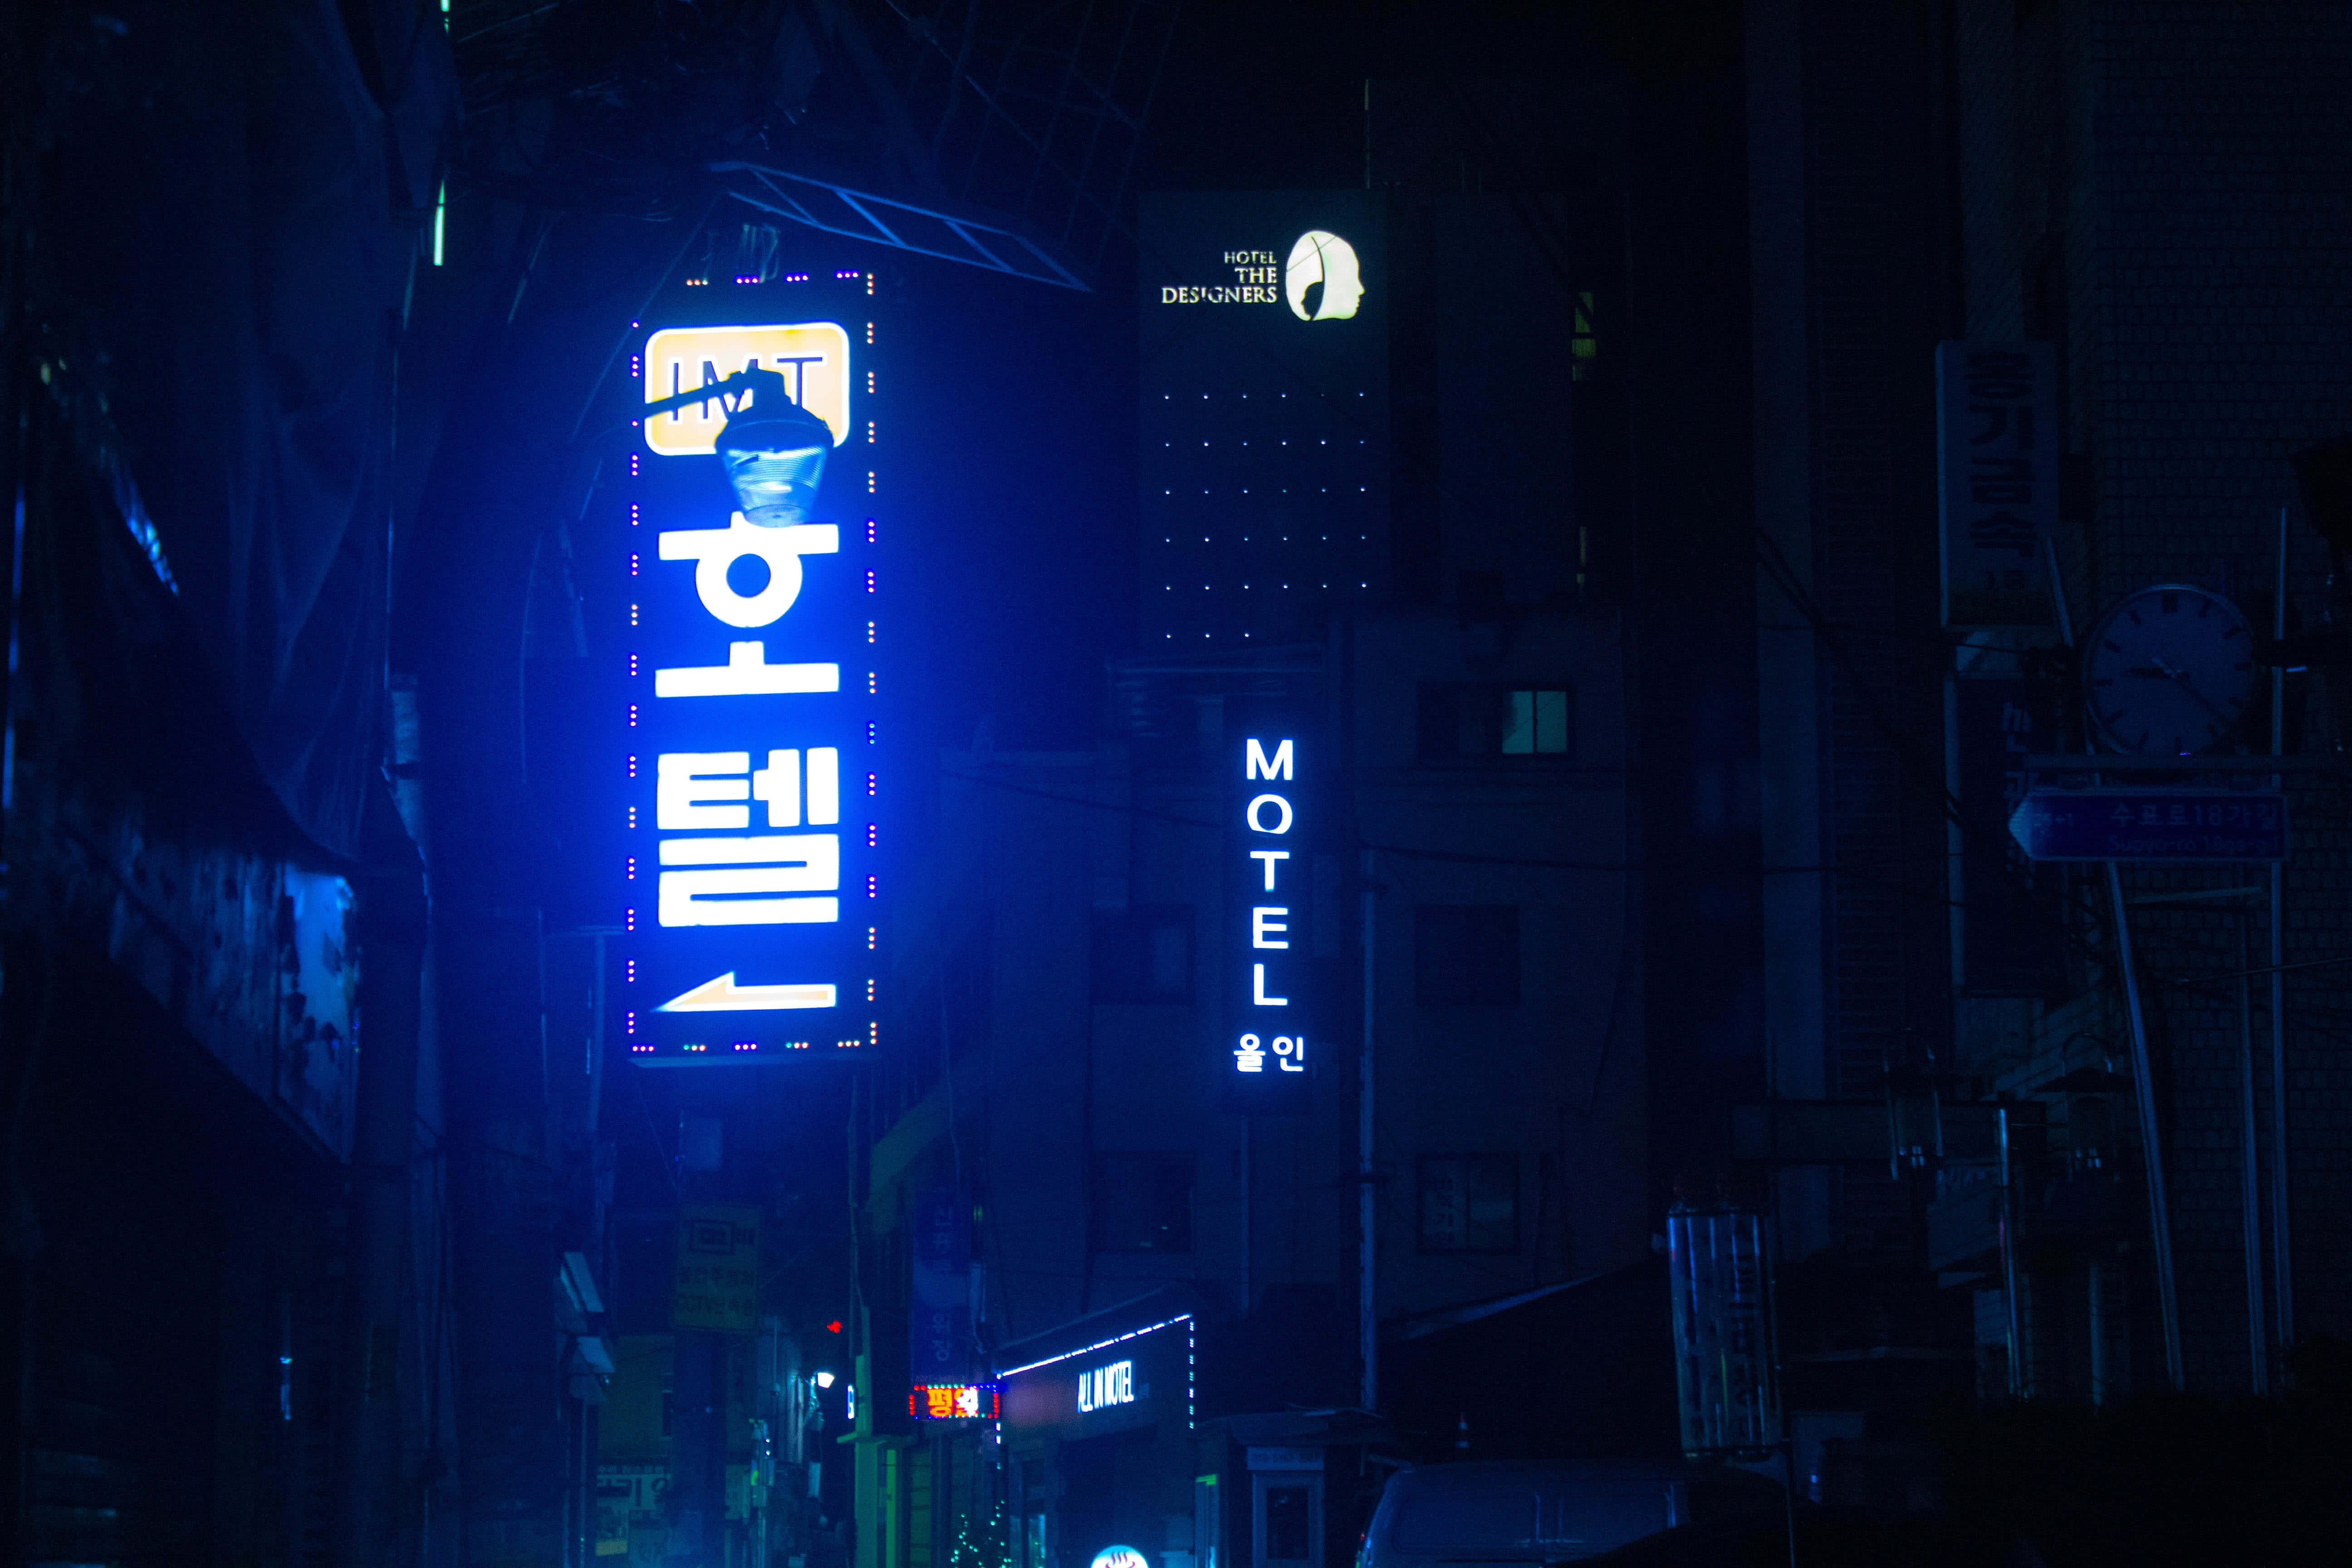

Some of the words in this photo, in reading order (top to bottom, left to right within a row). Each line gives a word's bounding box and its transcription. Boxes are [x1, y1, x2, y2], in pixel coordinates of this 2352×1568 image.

[1224, 251, 1277, 264] HOTEL
[1235, 268, 1277, 284] THE
[1161, 286, 1277, 304] DESIGNERS
[655, 509, 839, 927] 호텔
[2109, 802, 2278, 830] 수표로18가길
[1245, 738, 1294, 1006] MOTEL
[1233, 1033, 1304, 1073] 올인
[1078, 1372, 1093, 1412] ALL
[1094, 1368, 1103, 1409] IN
[1104, 1360, 1134, 1406] MOTEL
